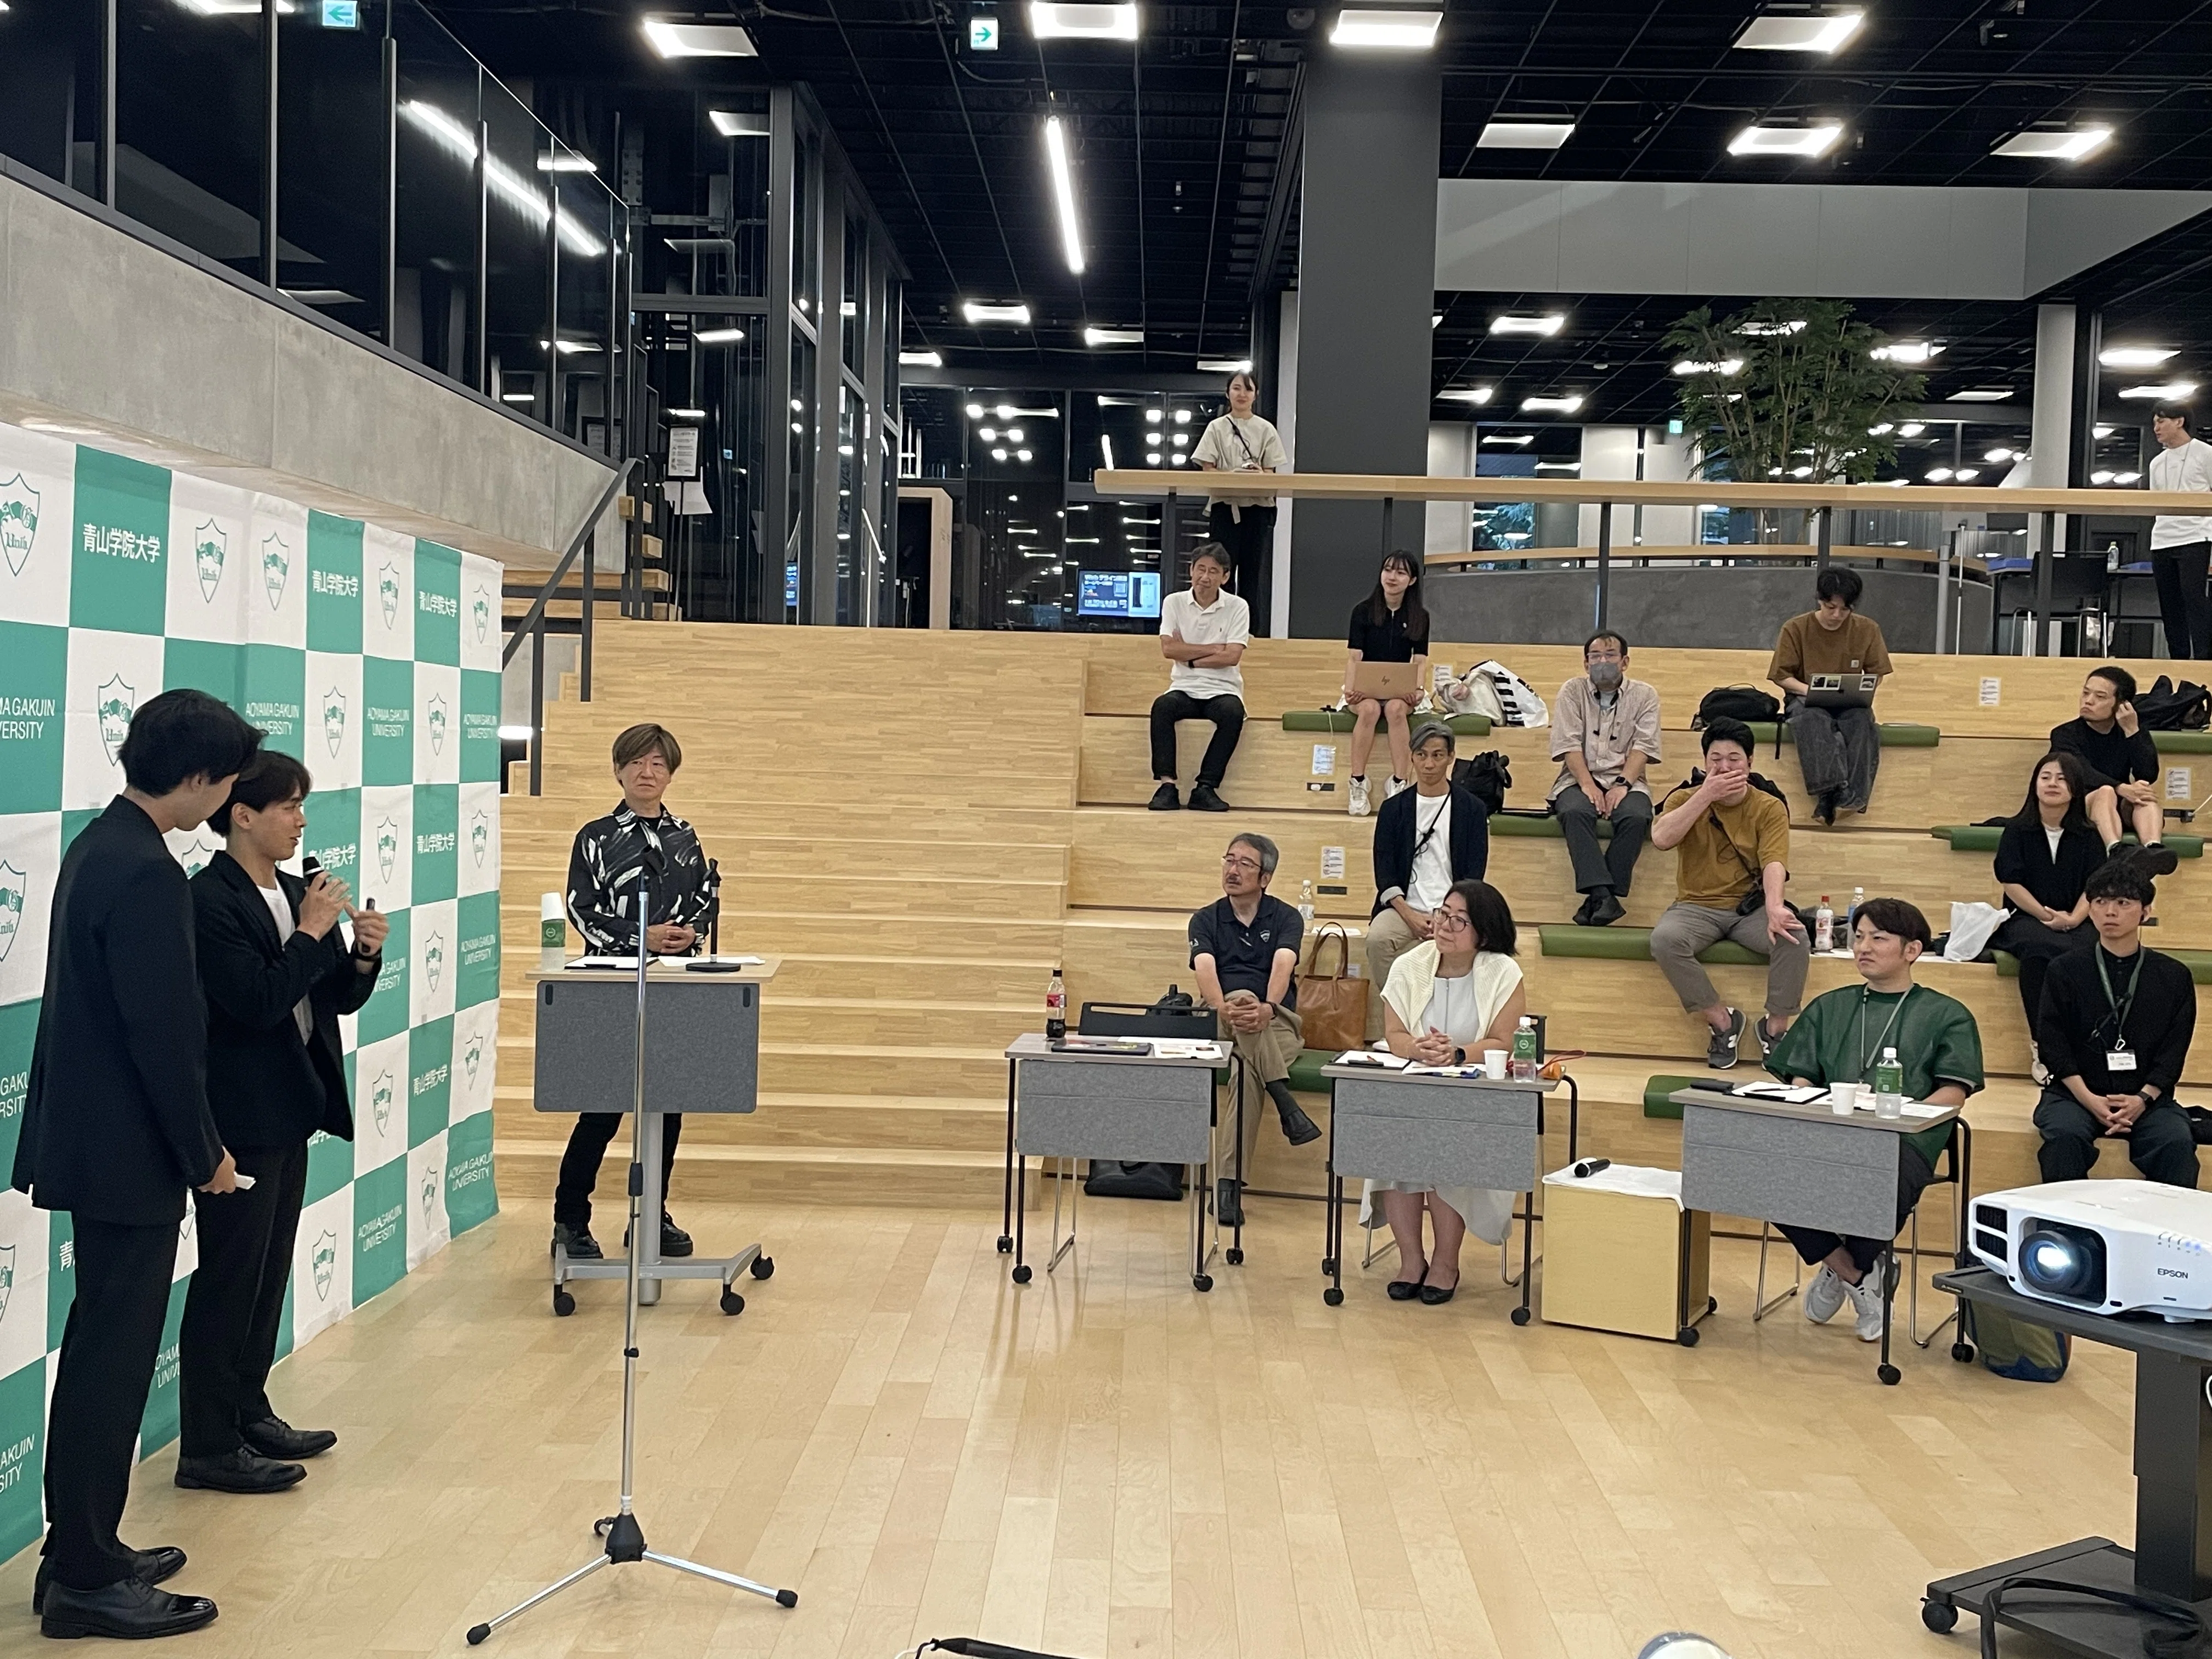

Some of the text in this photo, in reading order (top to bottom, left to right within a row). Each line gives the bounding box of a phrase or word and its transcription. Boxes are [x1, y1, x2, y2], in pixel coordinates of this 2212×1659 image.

[83, 523, 160, 563] 青山学院大学
[312, 570, 359, 597] 青山学院大学
[419, 591, 457, 618] 青山学院大学
[12, 697, 55, 716] GAKUIN
[417, 832, 455, 854] 青山学院大学
[413, 1064, 448, 1097] 青山学院大学
[452, 1166, 489, 1192] UNIVERSITY
[363, 1222, 396, 1252] UNIVERSITY
[2157, 1268, 2188, 1279] EPSON
